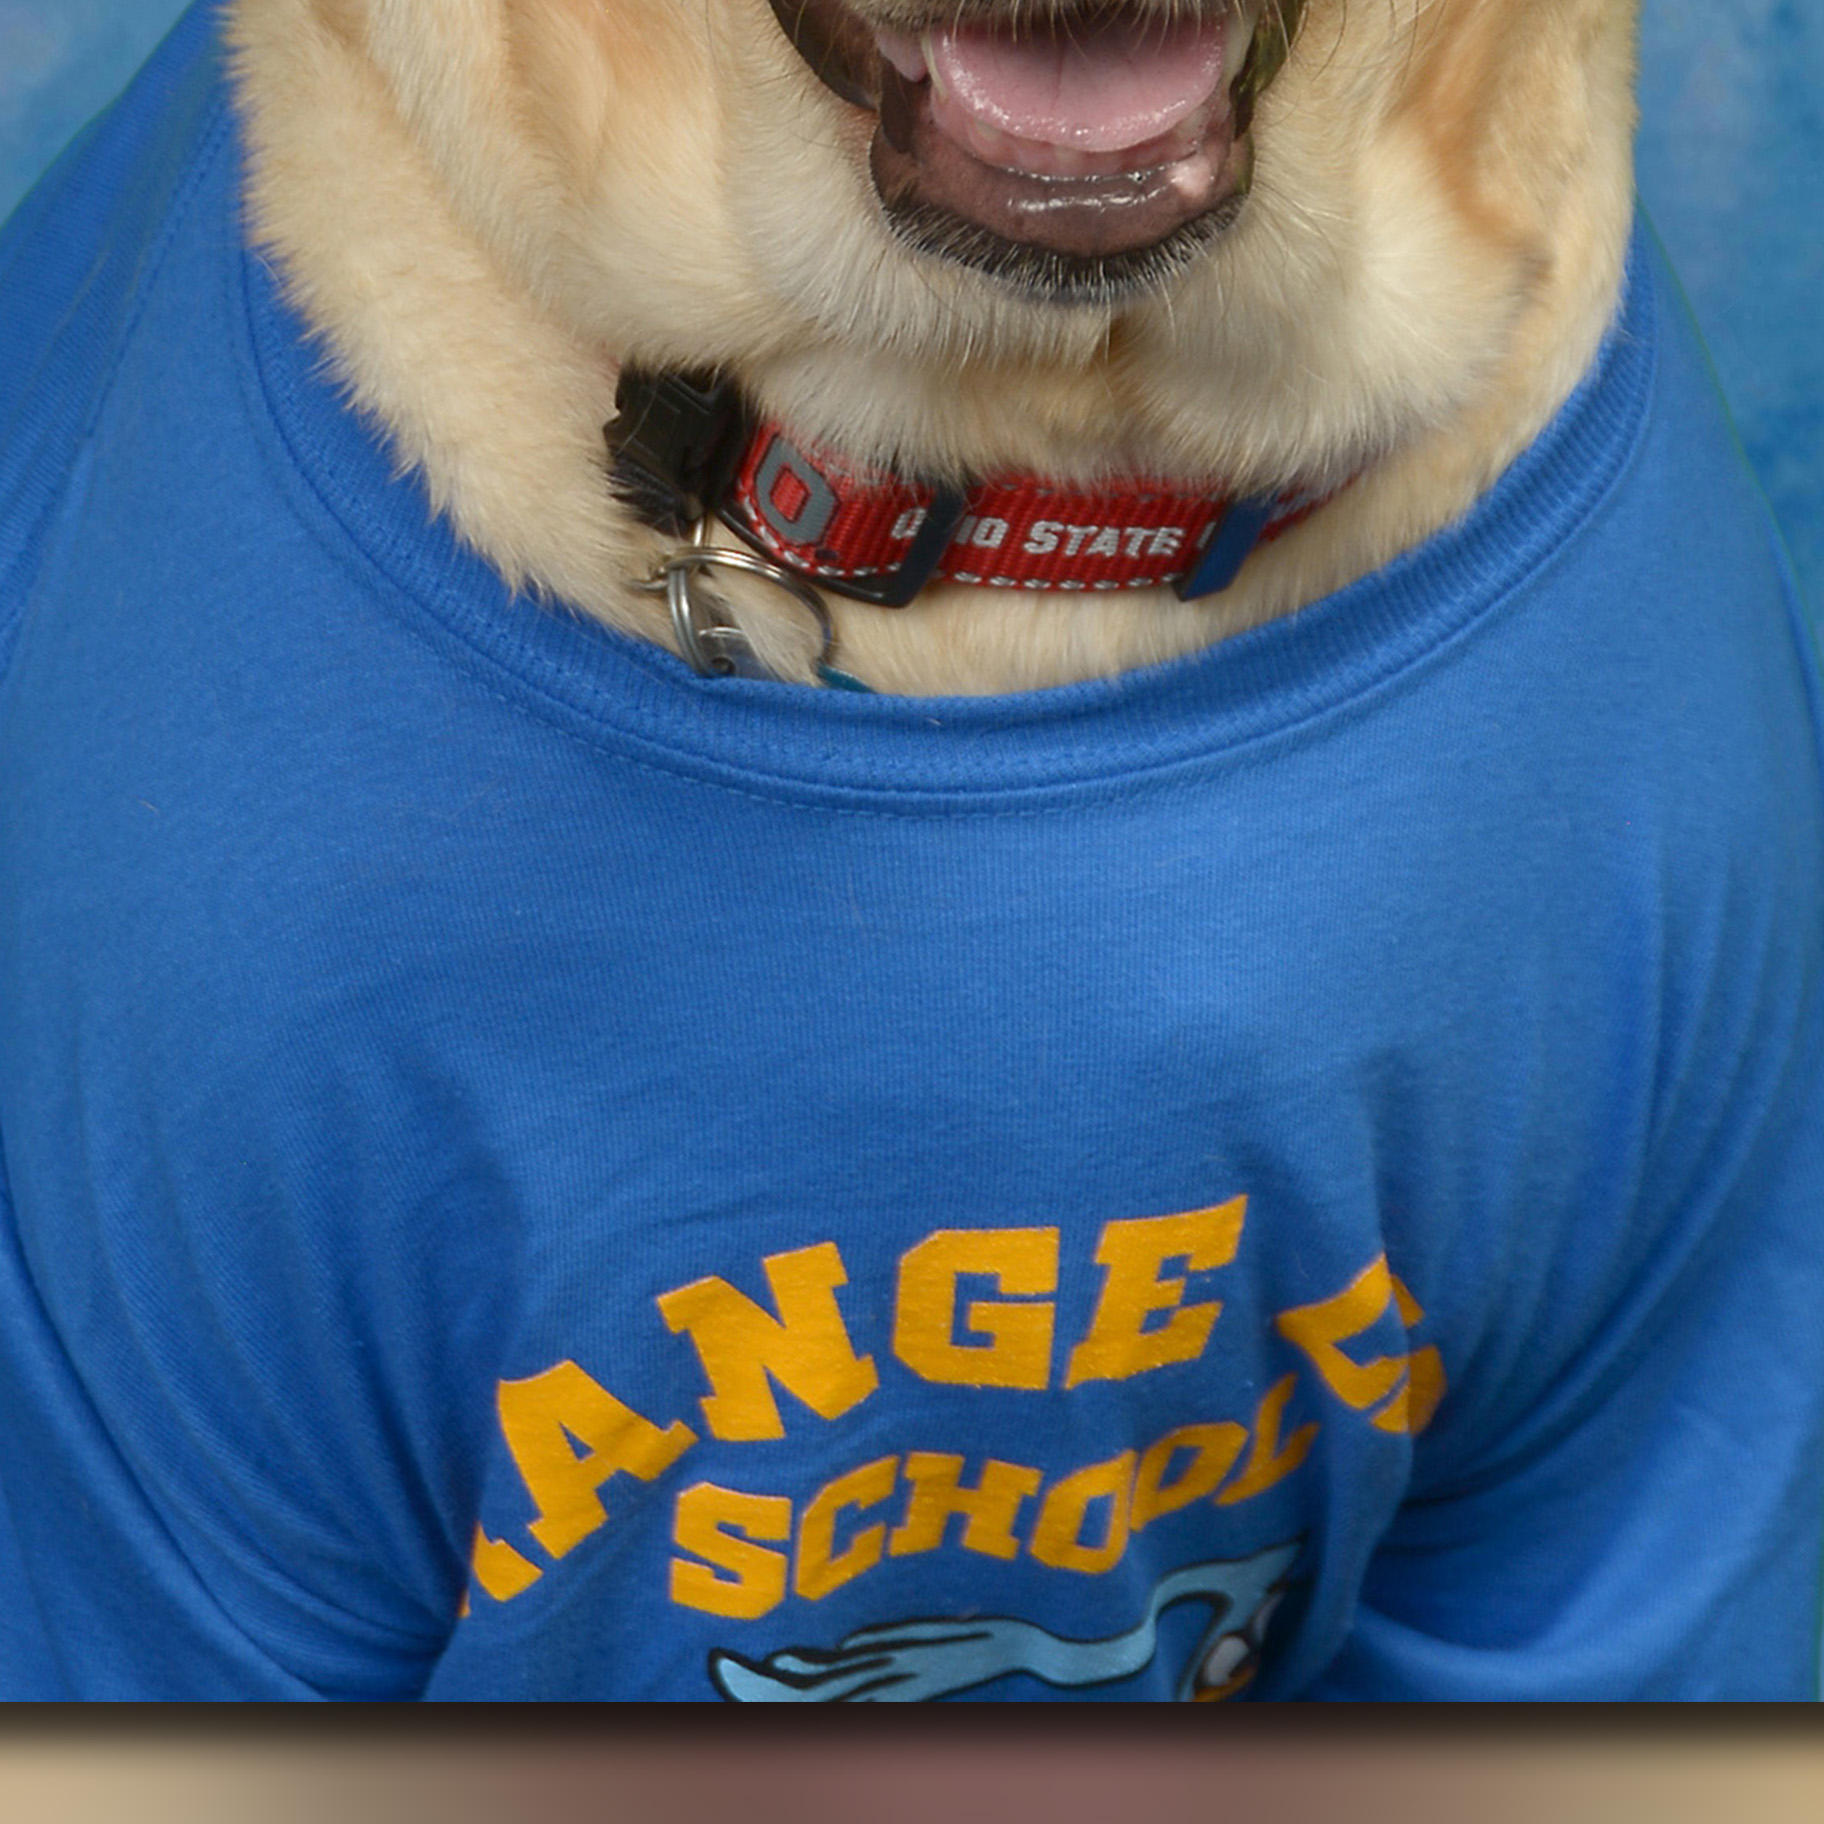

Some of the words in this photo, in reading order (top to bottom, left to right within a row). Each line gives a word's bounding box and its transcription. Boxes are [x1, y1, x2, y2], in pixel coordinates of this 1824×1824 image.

[890, 507, 1010, 549] OIO
[1024, 519, 1183, 558] STATE
[669, 1373, 1320, 1621] SCHOOL
